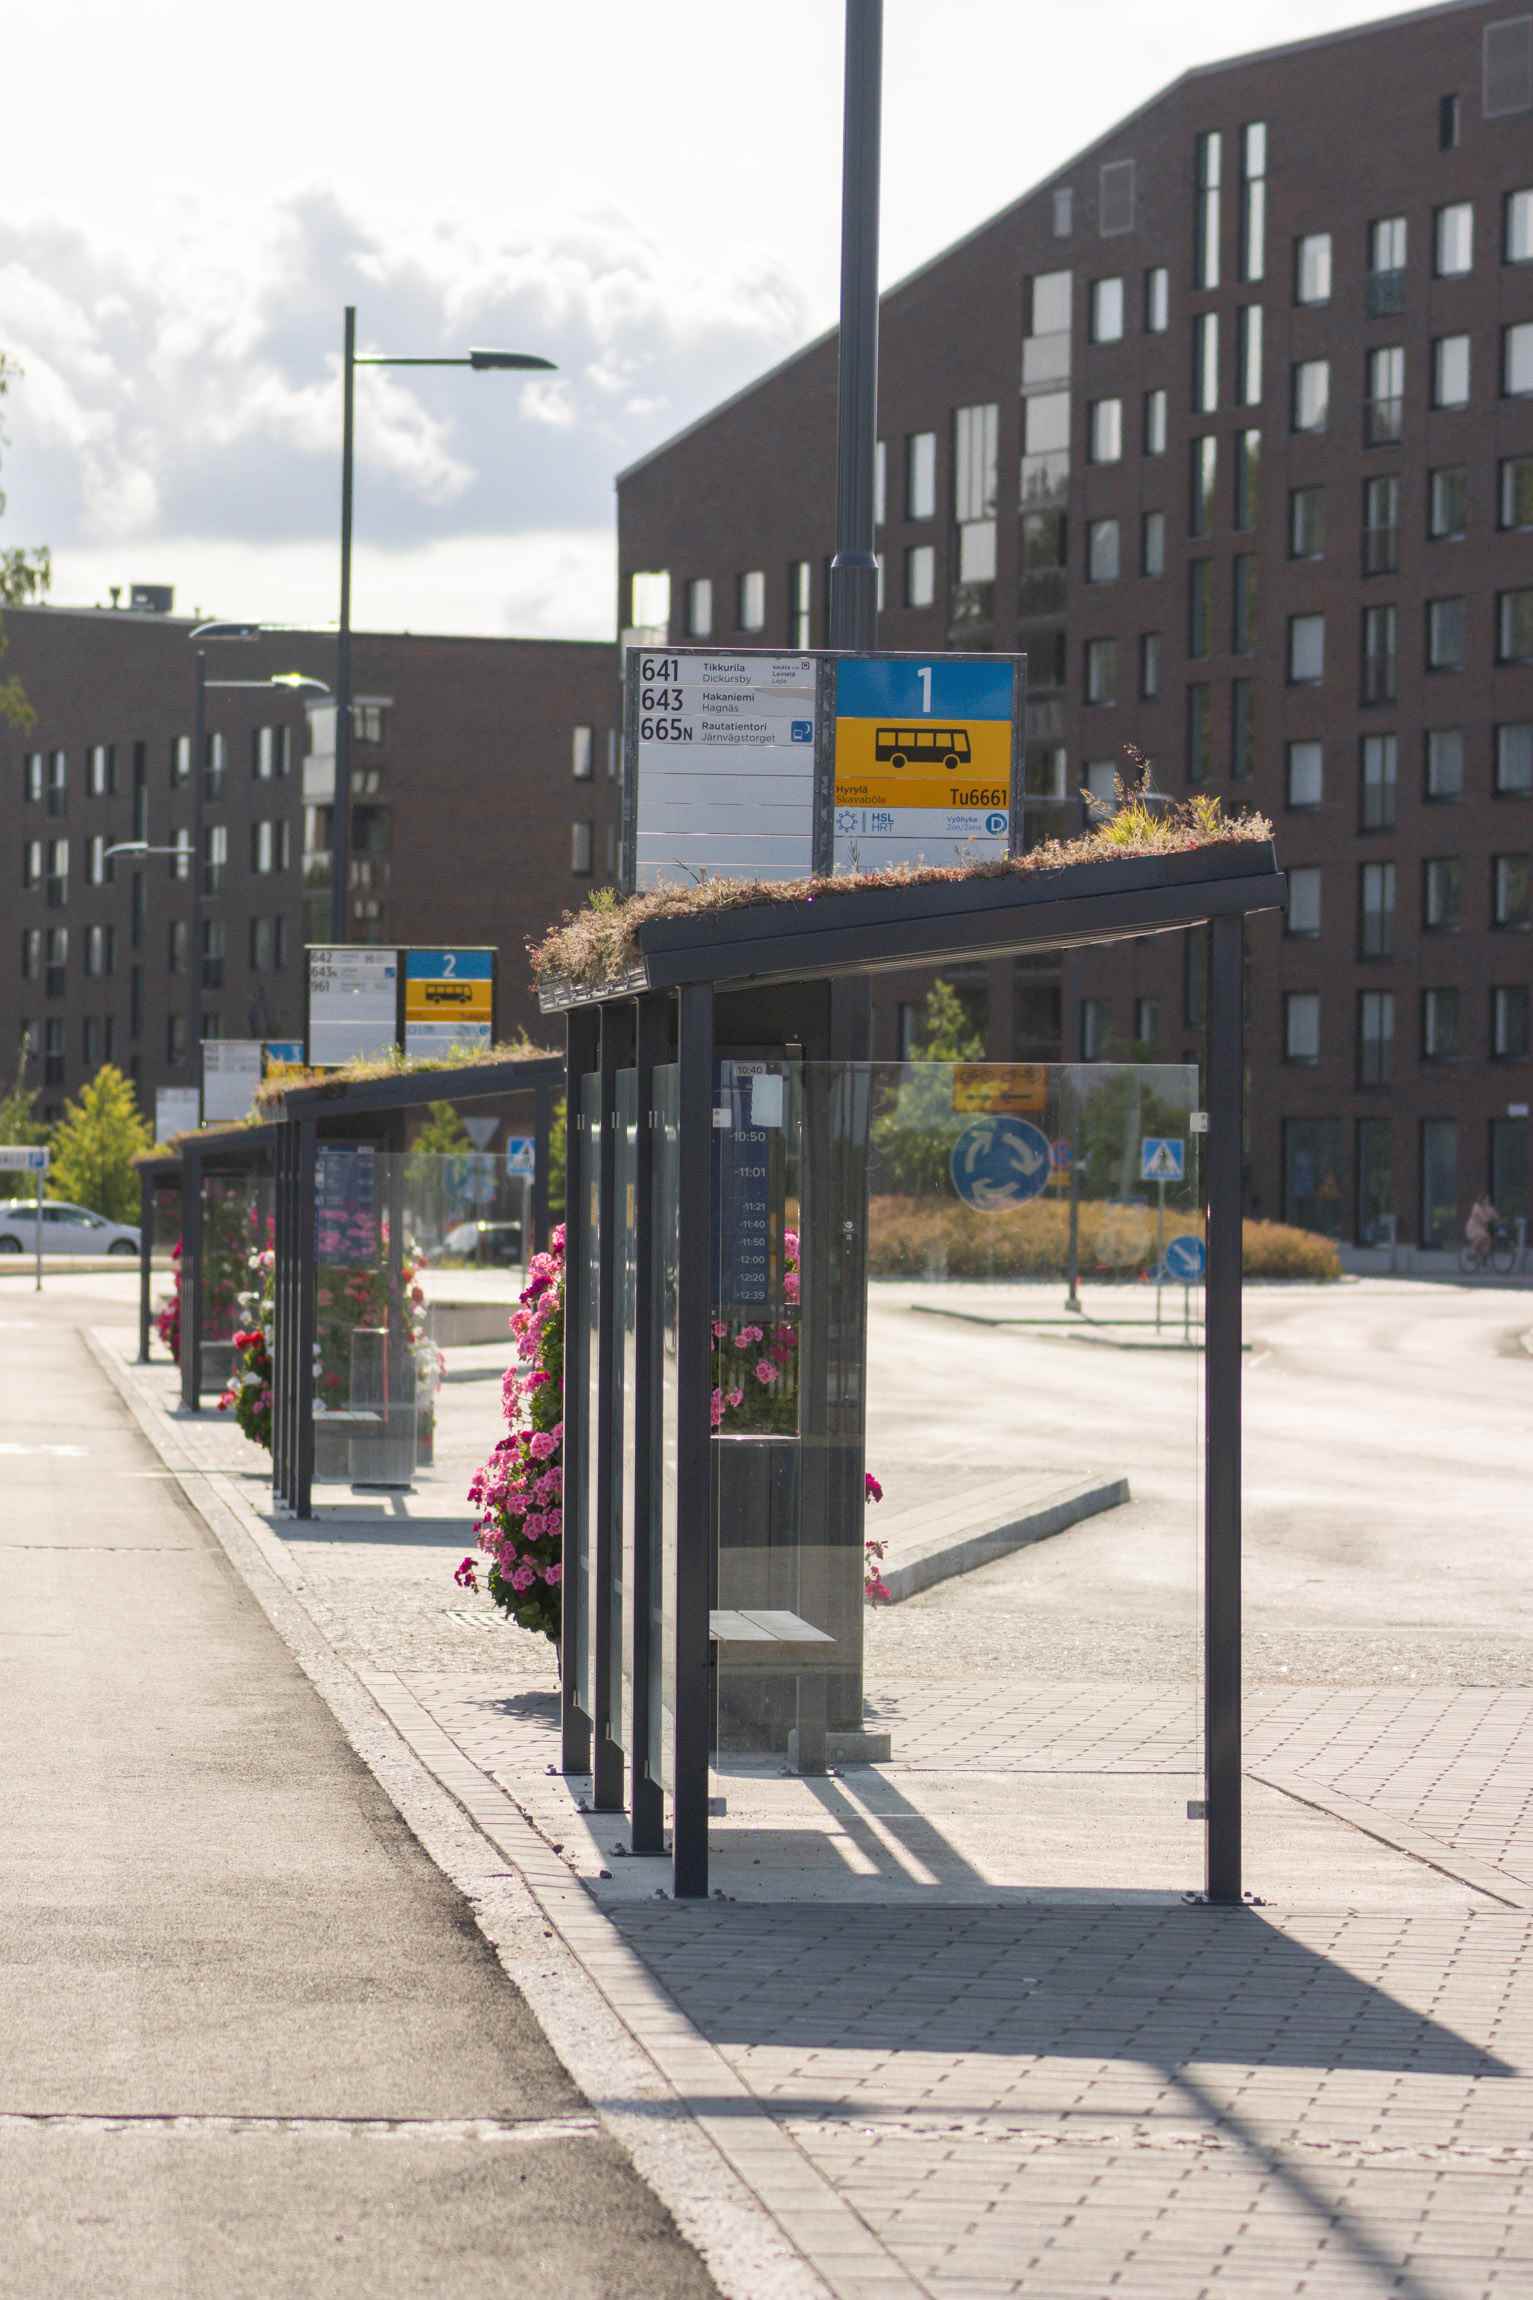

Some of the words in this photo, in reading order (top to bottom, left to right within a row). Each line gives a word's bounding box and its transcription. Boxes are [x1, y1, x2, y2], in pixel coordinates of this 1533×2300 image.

[641, 658, 680, 682] 641
[703, 663, 746, 672] Tikkurila
[703, 673, 752, 685] Dickursby
[916, 666, 933, 713] 1
[641, 688, 684, 712] 643
[702, 693, 755, 703] Hakaniemi
[702, 704, 740, 713] Hagnäs
[640, 717, 694, 741] 665N
[702, 722, 768, 732] Rautatientori
[949, 788, 1008, 806] Tu6661
[871, 812, 895, 823] HSL
[871, 823, 895, 832] HRT
[442, 954, 457, 978] 2
